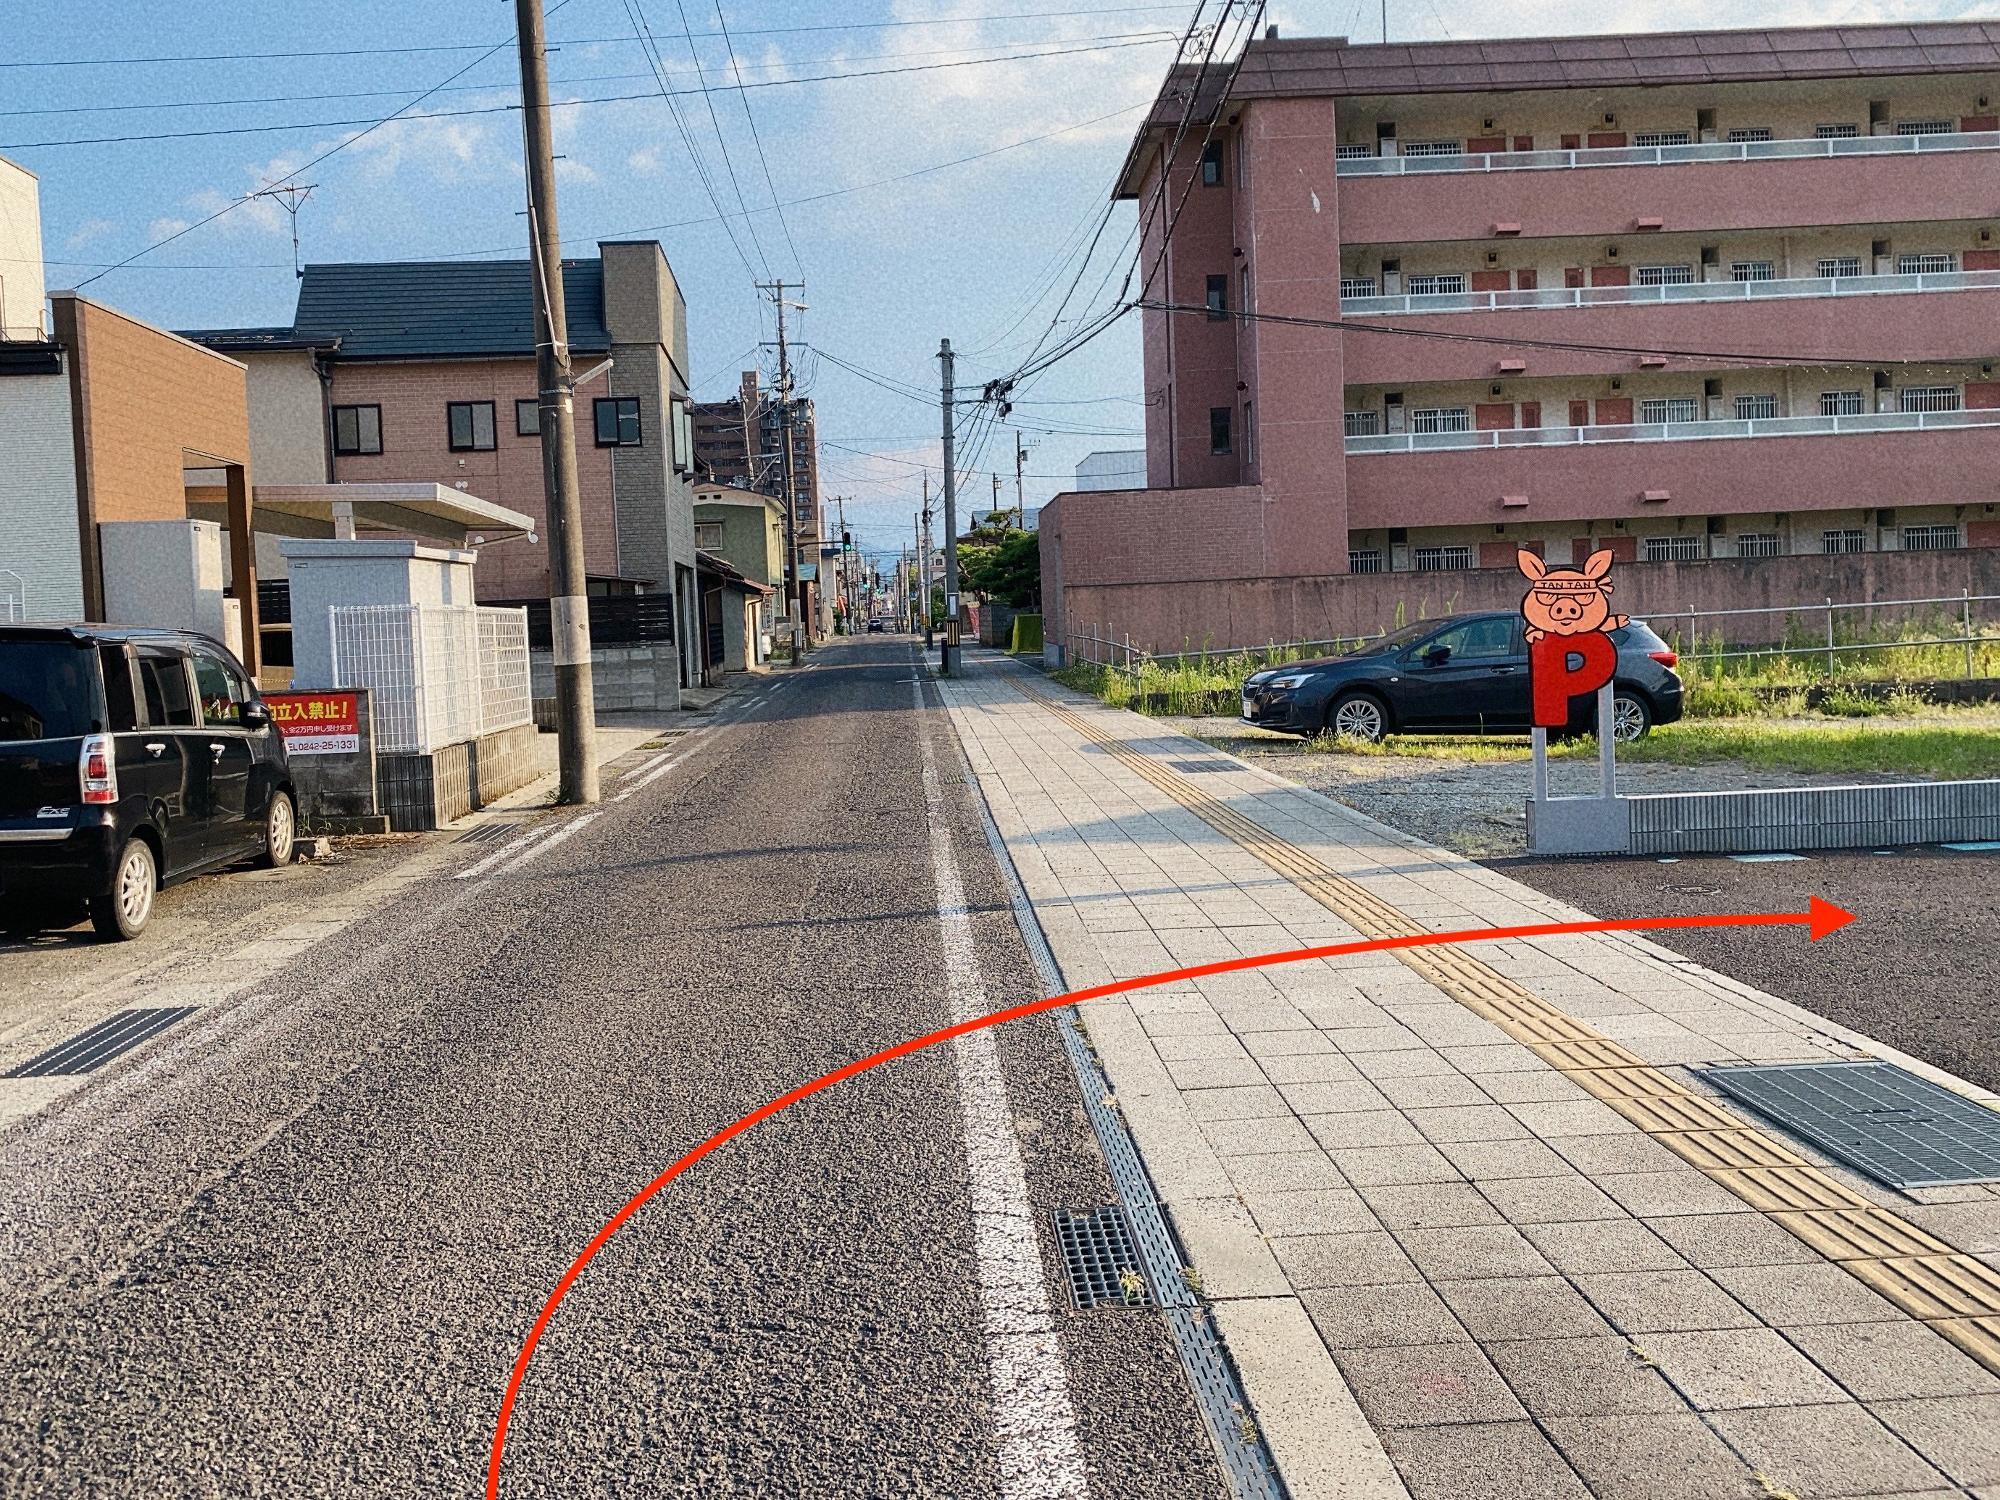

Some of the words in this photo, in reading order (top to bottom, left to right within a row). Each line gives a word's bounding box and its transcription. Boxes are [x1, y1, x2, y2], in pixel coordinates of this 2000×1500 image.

[1540, 581, 1564, 589] TAN
[1567, 581, 1591, 589] TAN
[1530, 631, 1618, 727] P
